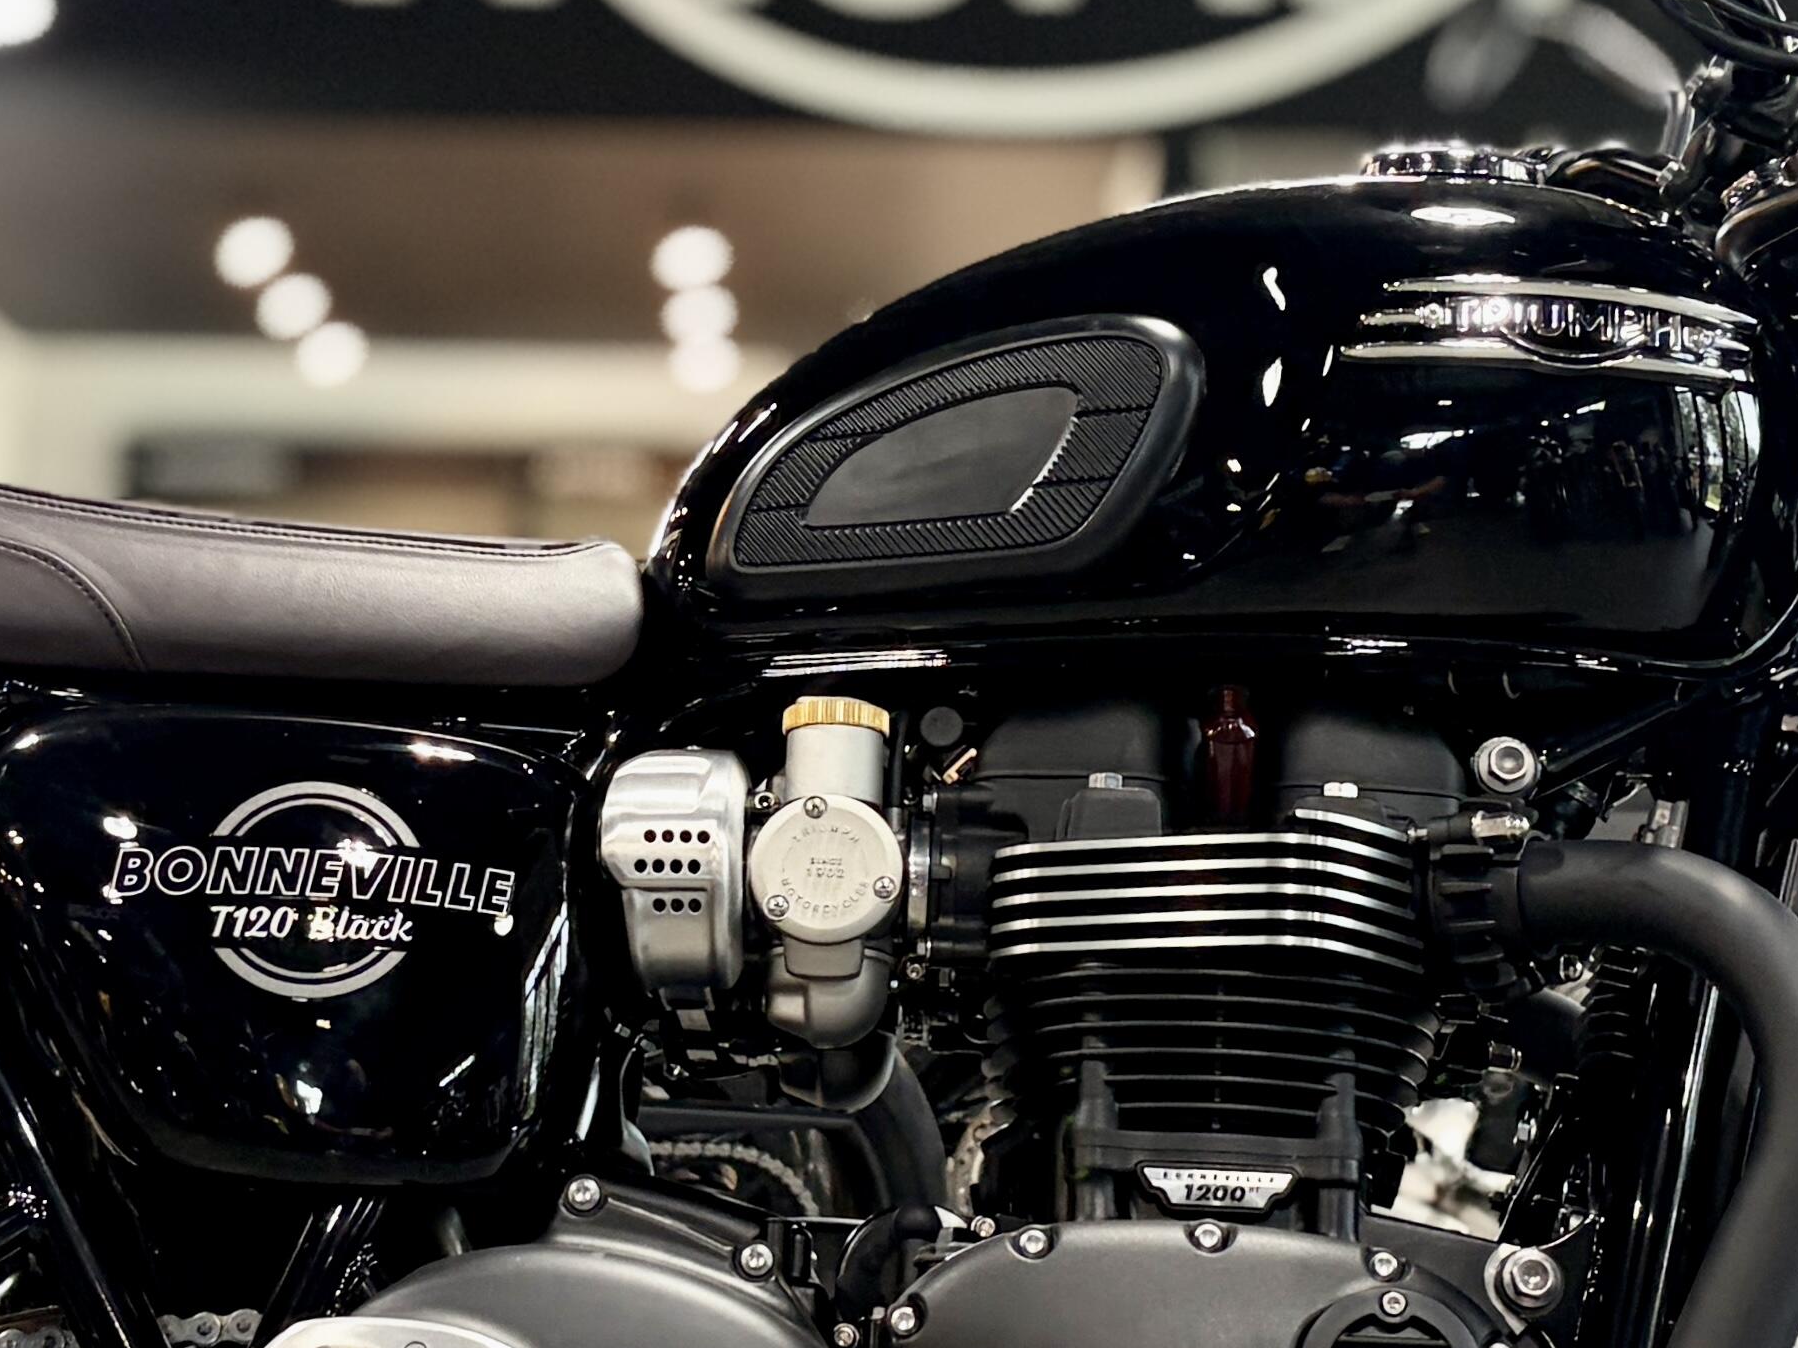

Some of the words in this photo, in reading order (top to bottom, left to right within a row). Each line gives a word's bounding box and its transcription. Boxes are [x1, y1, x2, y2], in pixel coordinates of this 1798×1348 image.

[111, 845, 516, 915] BONNEVILLE
[209, 905, 295, 939] T120
[308, 905, 413, 942] Black
[1184, 1183, 1247, 1203] 1200
